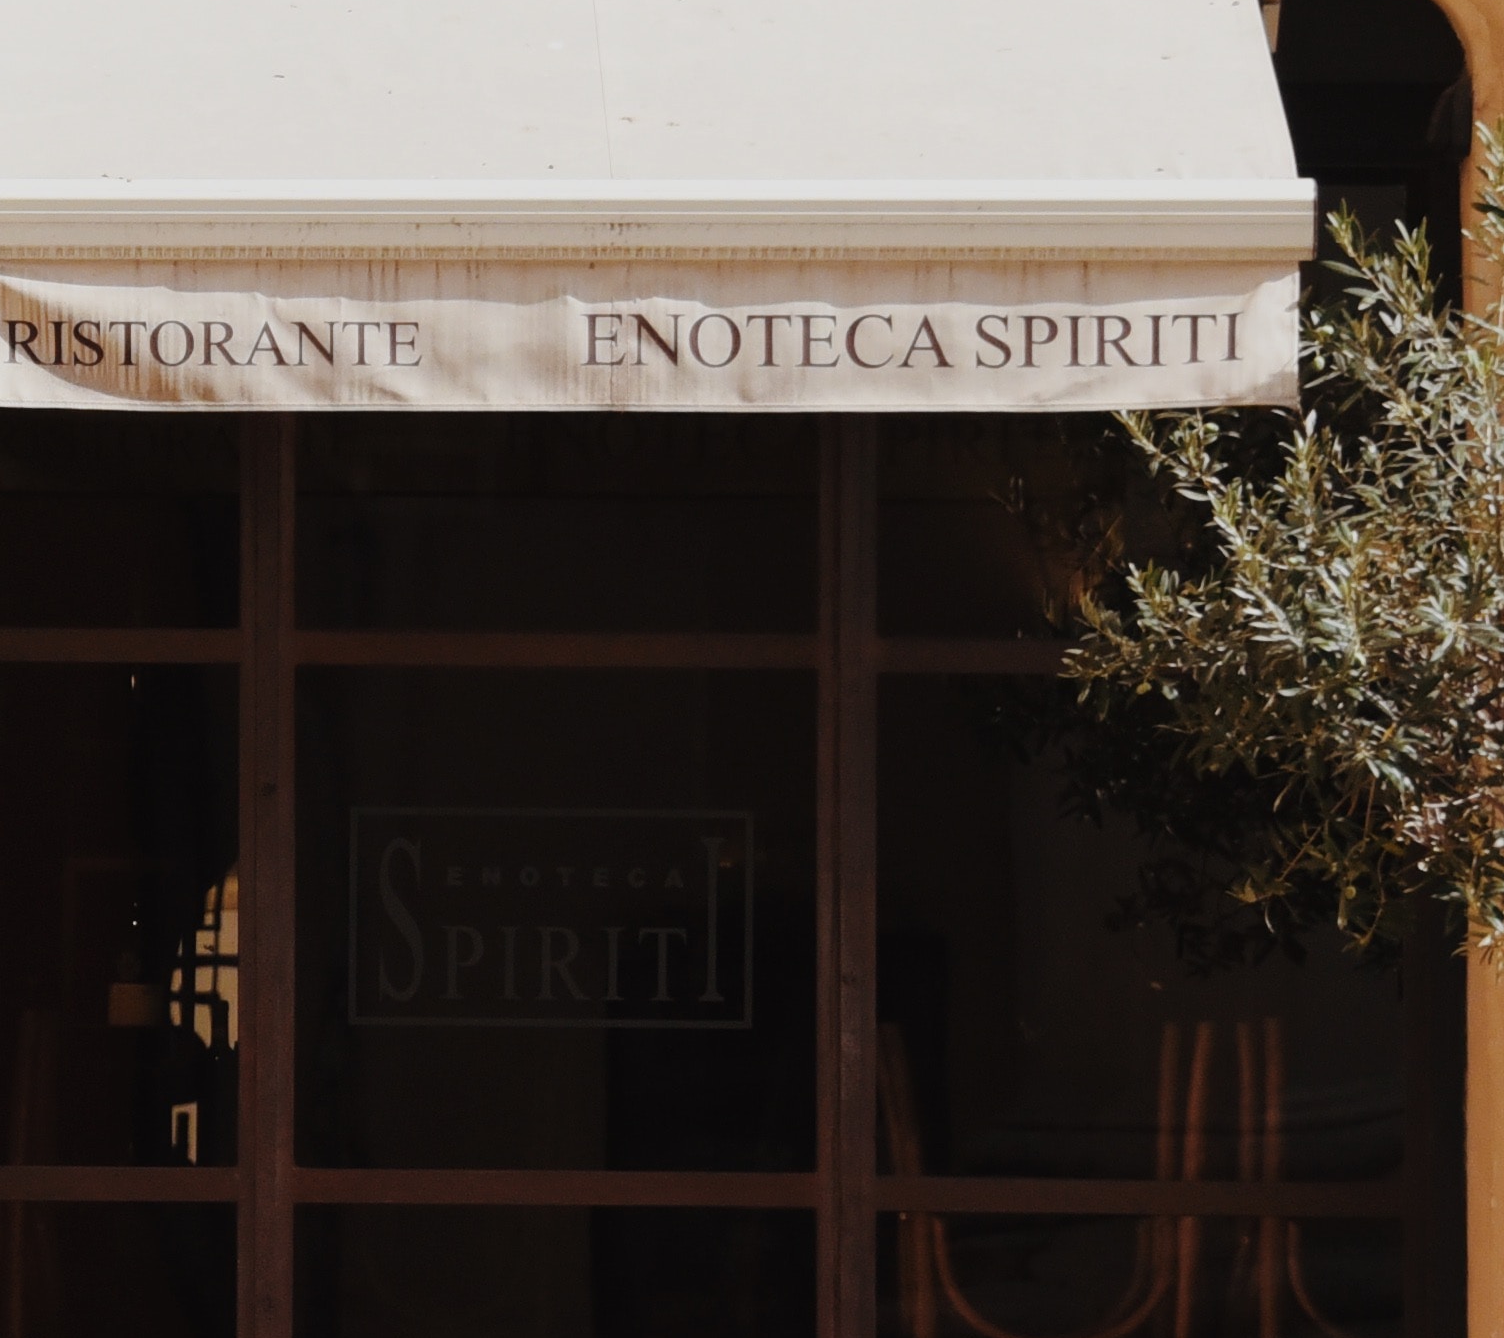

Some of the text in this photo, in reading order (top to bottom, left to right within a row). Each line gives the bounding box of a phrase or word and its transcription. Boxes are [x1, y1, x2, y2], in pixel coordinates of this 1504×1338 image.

[2, 310, 1244, 370] RISTORANTE ENOTECA SPIRITI
[446, 865, 685, 889] ENOTECA
[377, 835, 727, 1004] SPIRITI
